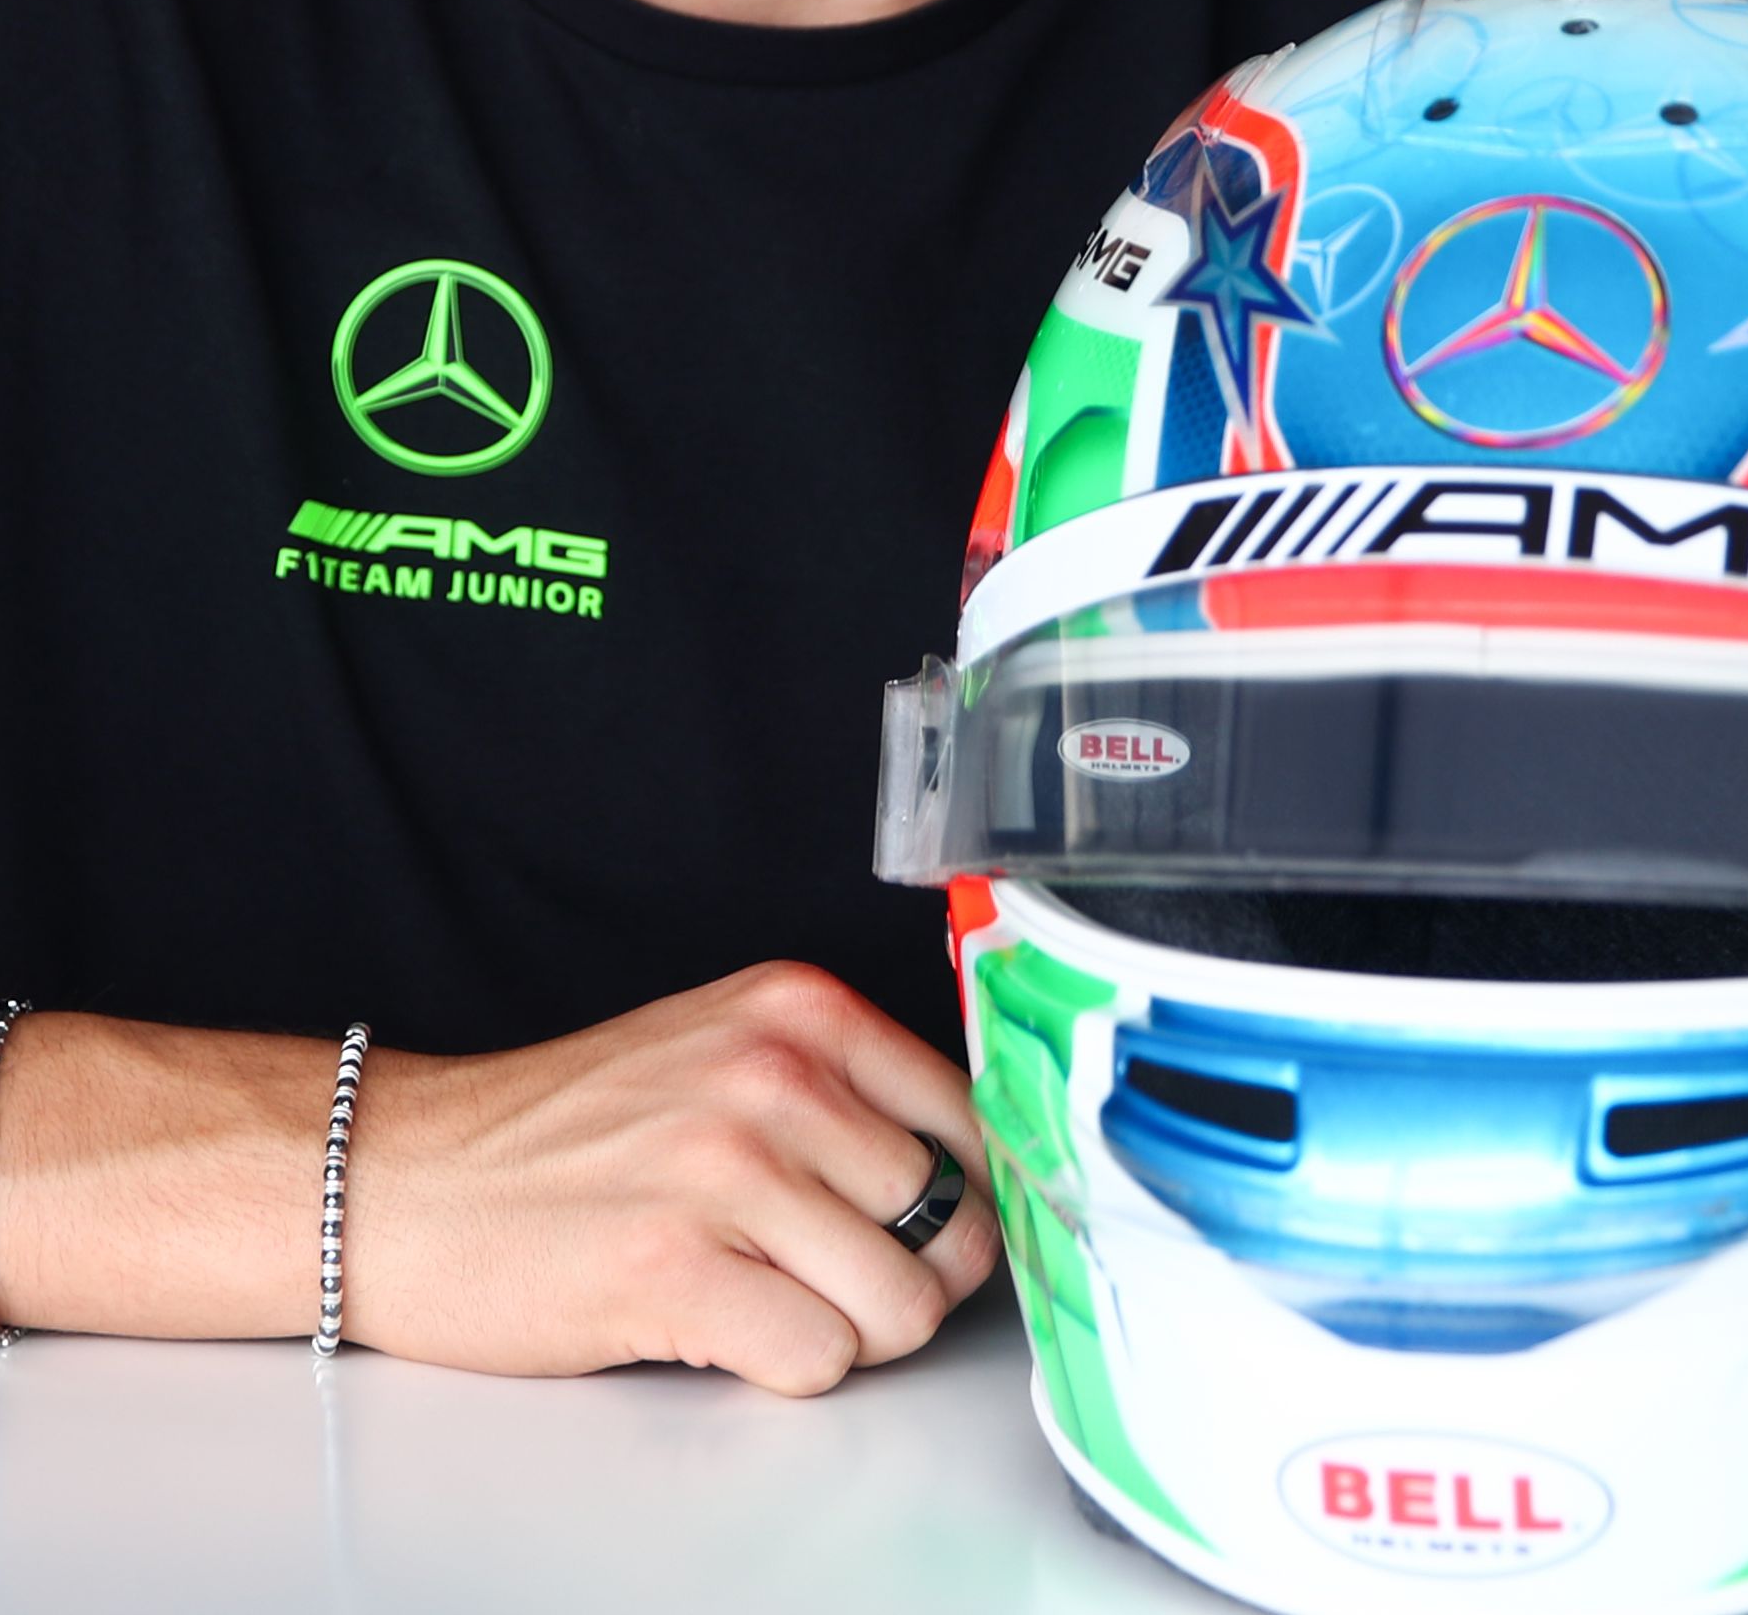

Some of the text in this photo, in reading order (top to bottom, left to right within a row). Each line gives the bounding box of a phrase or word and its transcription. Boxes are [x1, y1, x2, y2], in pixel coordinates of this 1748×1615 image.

[363, 511, 610, 581] AMG
[274, 547, 605, 621] F1 TEAM JUNIOR
[1080, 734, 1174, 763] BELL
[1320, 1460, 1565, 1533] BELL
